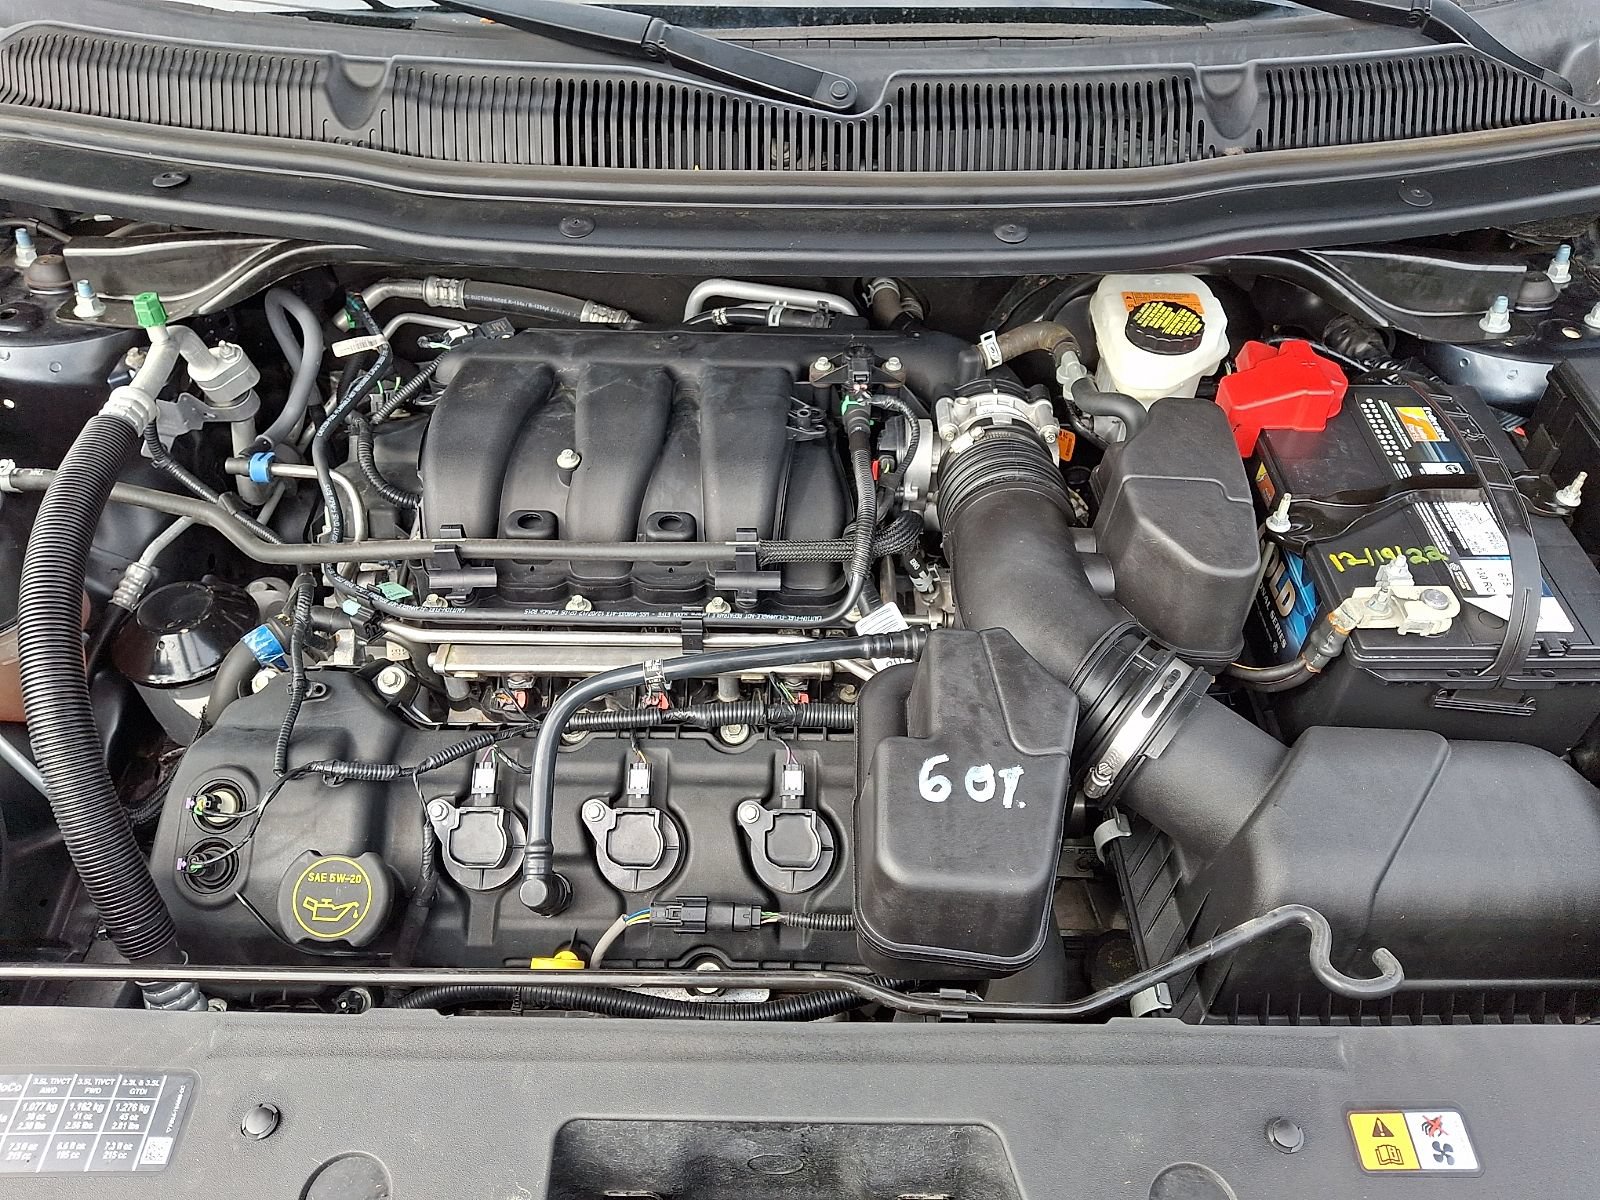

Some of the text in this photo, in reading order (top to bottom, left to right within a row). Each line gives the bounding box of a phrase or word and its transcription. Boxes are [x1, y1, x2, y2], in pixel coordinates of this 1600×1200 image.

[1263, 549, 1296, 617] OLD
[1269, 612, 1287, 649] SERIES
[307, 872, 363, 884] SAE 5W-20
[77, 1078, 94, 1086] 3.5L
[39, 1087, 58, 1095] AWD
[84, 1087, 102, 1095] FWD
[22, 1102, 58, 1114] 1.077 kg
[69, 1102, 105, 1114] 1.162 kg
[115, 1102, 150, 1115] 1.276 kg
[82, 1121, 94, 1130] lbs
[127, 1121, 140, 1130] lbs
